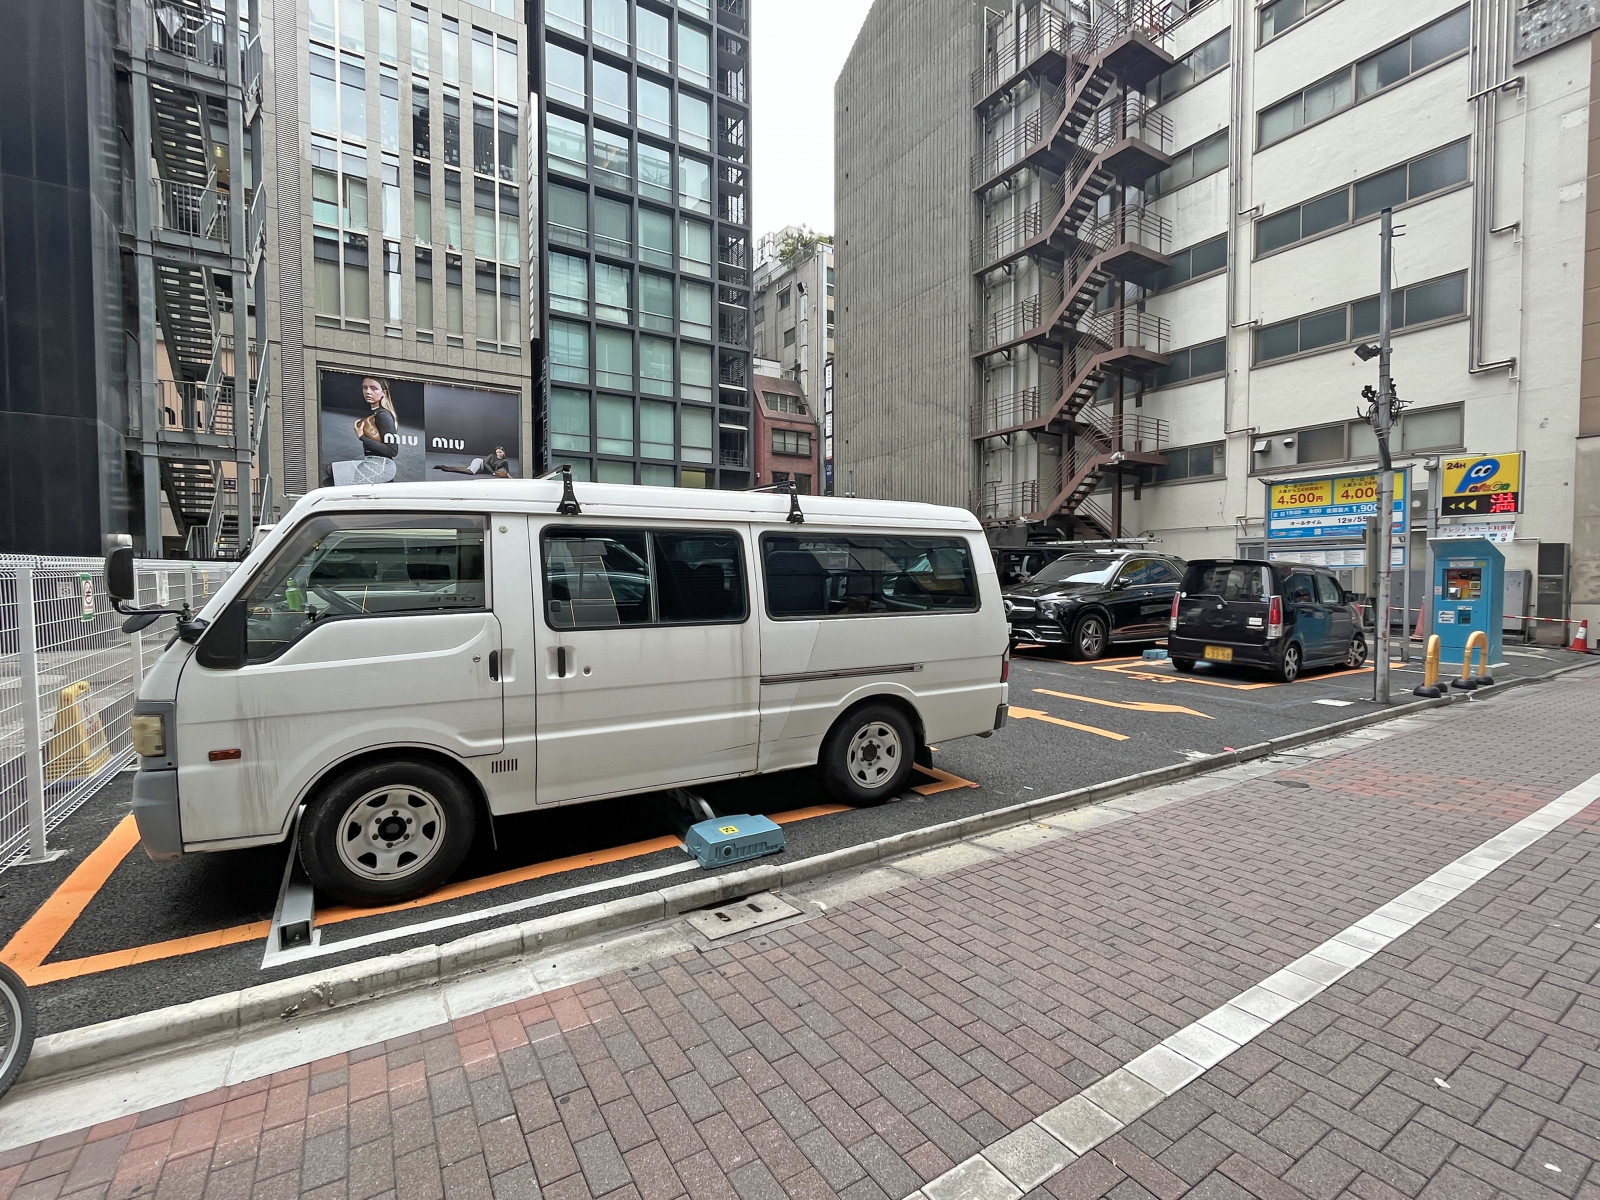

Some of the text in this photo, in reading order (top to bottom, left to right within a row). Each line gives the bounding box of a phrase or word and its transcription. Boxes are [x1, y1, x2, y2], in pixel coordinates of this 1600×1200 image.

[1446, 462, 1466, 470] 24H
[1277, 493, 1324, 505] 4,500円
[1490, 493, 1515, 513] 満
[1337, 515, 1370, 524] 12分/55
[1442, 525, 1515, 533] クレジットカード利用可
